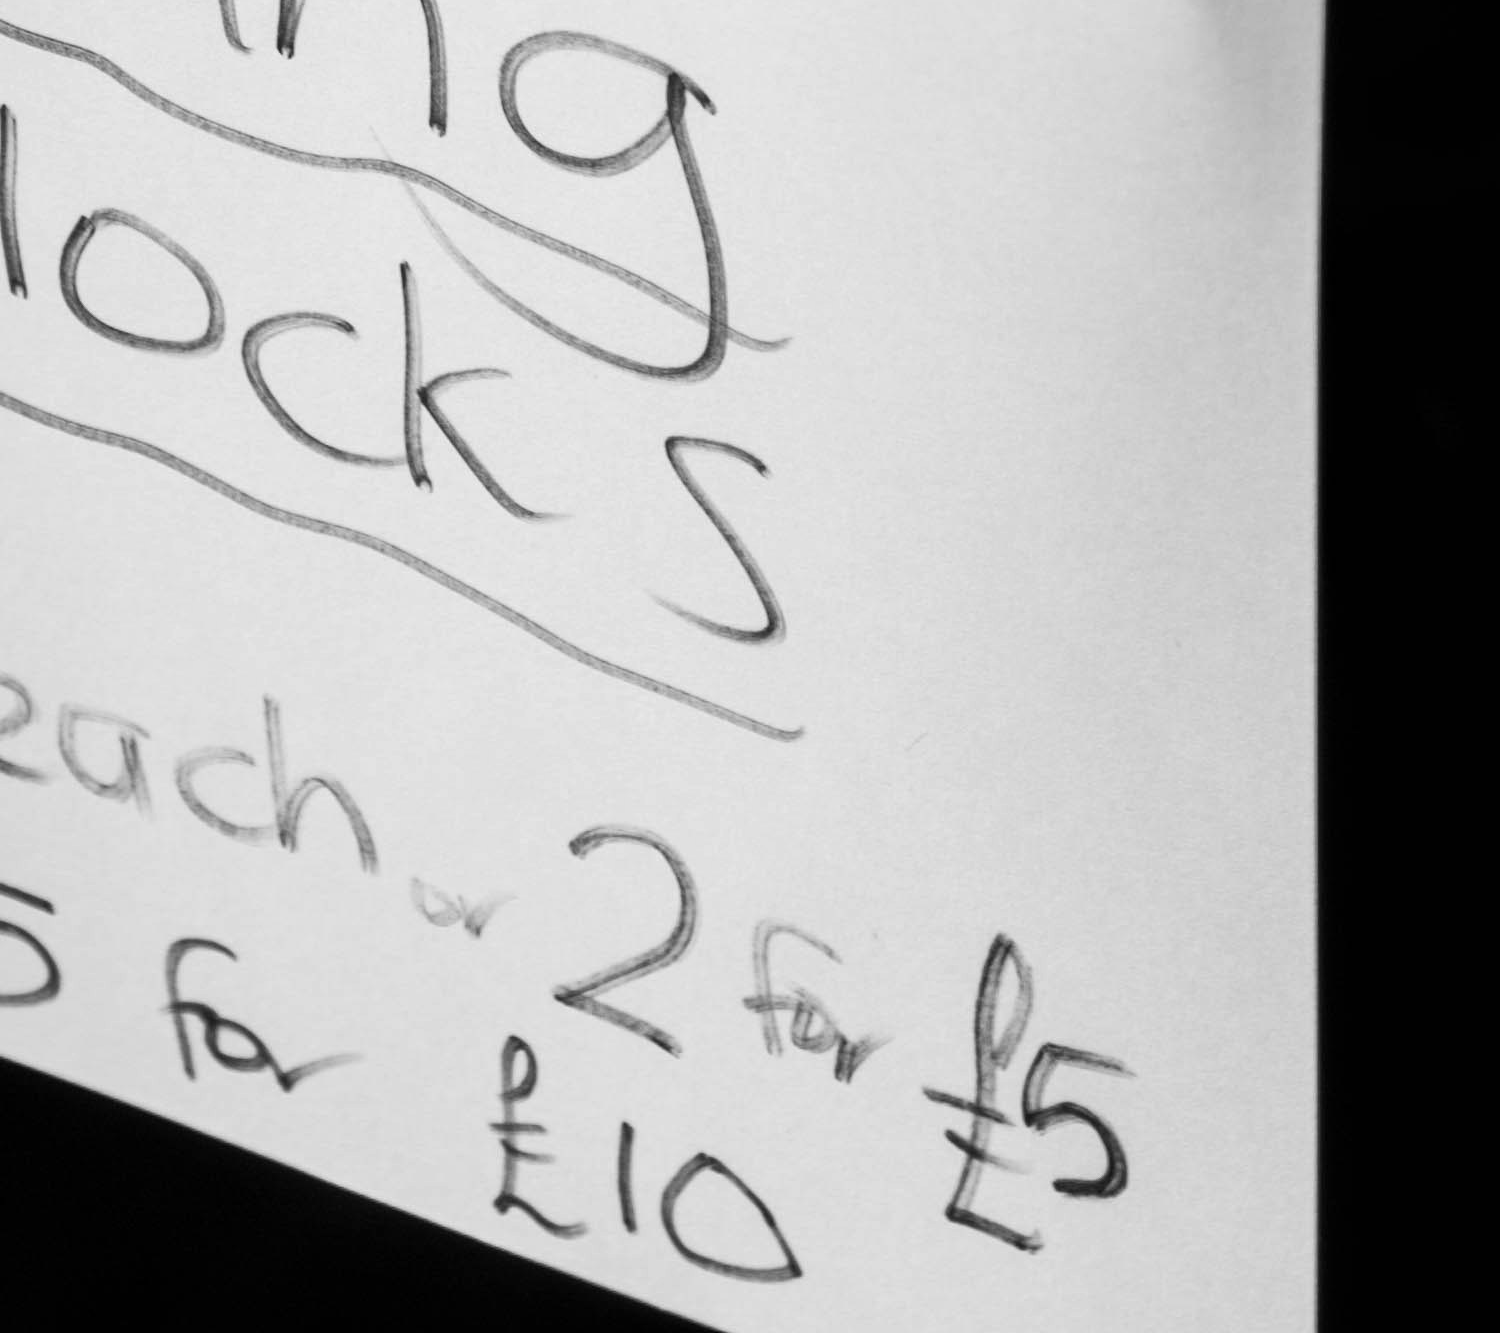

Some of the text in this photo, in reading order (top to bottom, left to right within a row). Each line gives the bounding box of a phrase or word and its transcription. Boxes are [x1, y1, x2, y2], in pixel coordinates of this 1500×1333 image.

[162, 935, 364, 1095] for
[486, 1033, 807, 1285] £10
[552, 823, 701, 1060] 2
[740, 917, 895, 1085] for
[921, 931, 1136, 1257] £5
